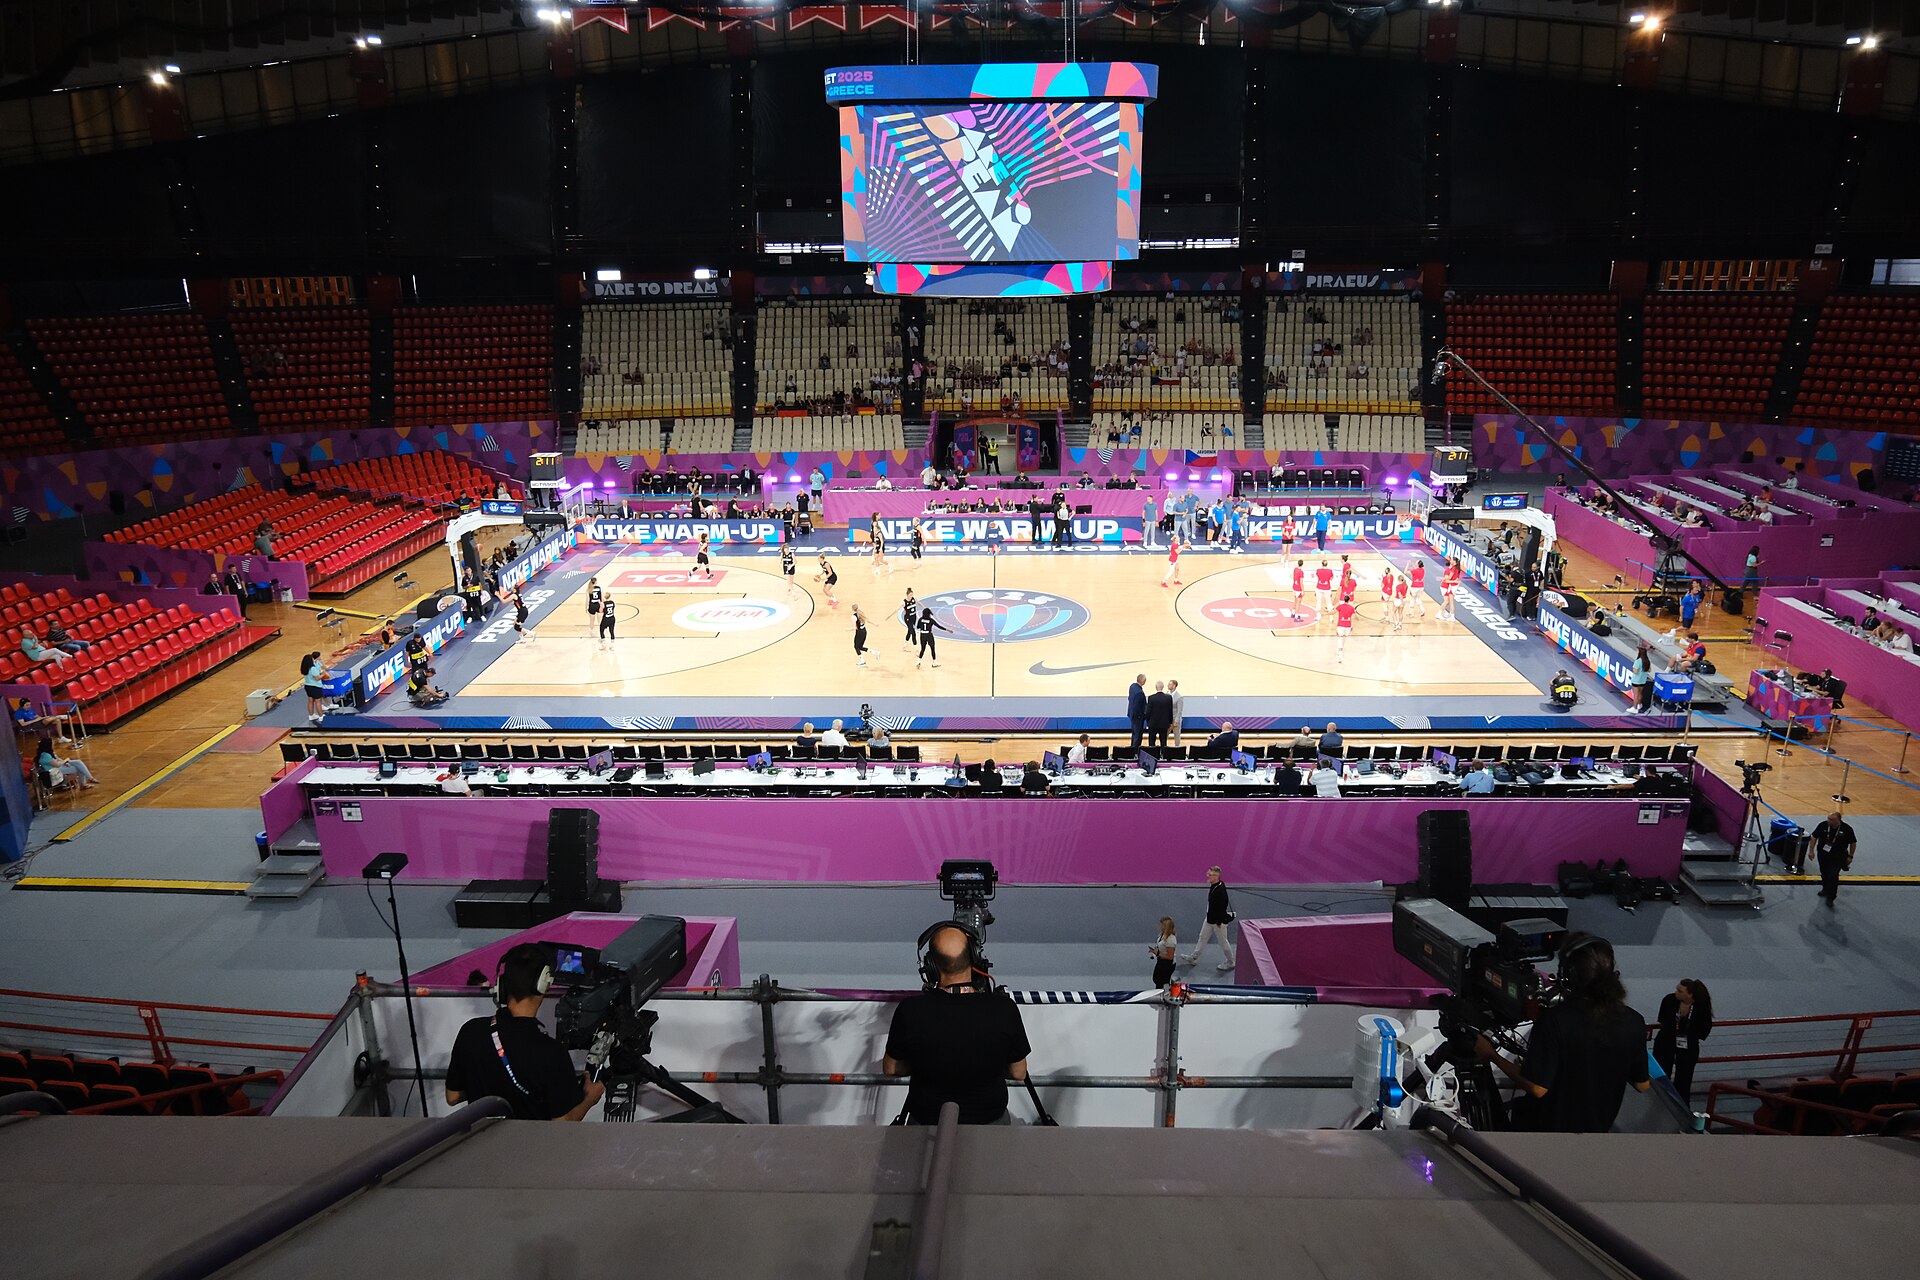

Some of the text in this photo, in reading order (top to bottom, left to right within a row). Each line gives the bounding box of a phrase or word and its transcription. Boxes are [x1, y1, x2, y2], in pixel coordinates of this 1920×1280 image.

[838, 71, 873, 82] 2025
[828, 85, 874, 96] GREECE
[951, 110, 1031, 225] DARE TO
[922, 114, 1022, 253] DREAM
[595, 282, 718, 295] DARE TO DREAM
[1306, 275, 1379, 287] PIRAEUS
[587, 524, 776, 540] NIKE WARM-UP
[878, 520, 955, 540] NIKE
[502, 529, 575, 591] NIKE WARM-UP
[1423, 526, 1495, 586] NIKE WARM-UP
[626, 574, 714, 583] TCL
[1210, 608, 1310, 617] TCL
[1540, 608, 1571, 643] NIKE
[367, 650, 404, 691] NIKE
